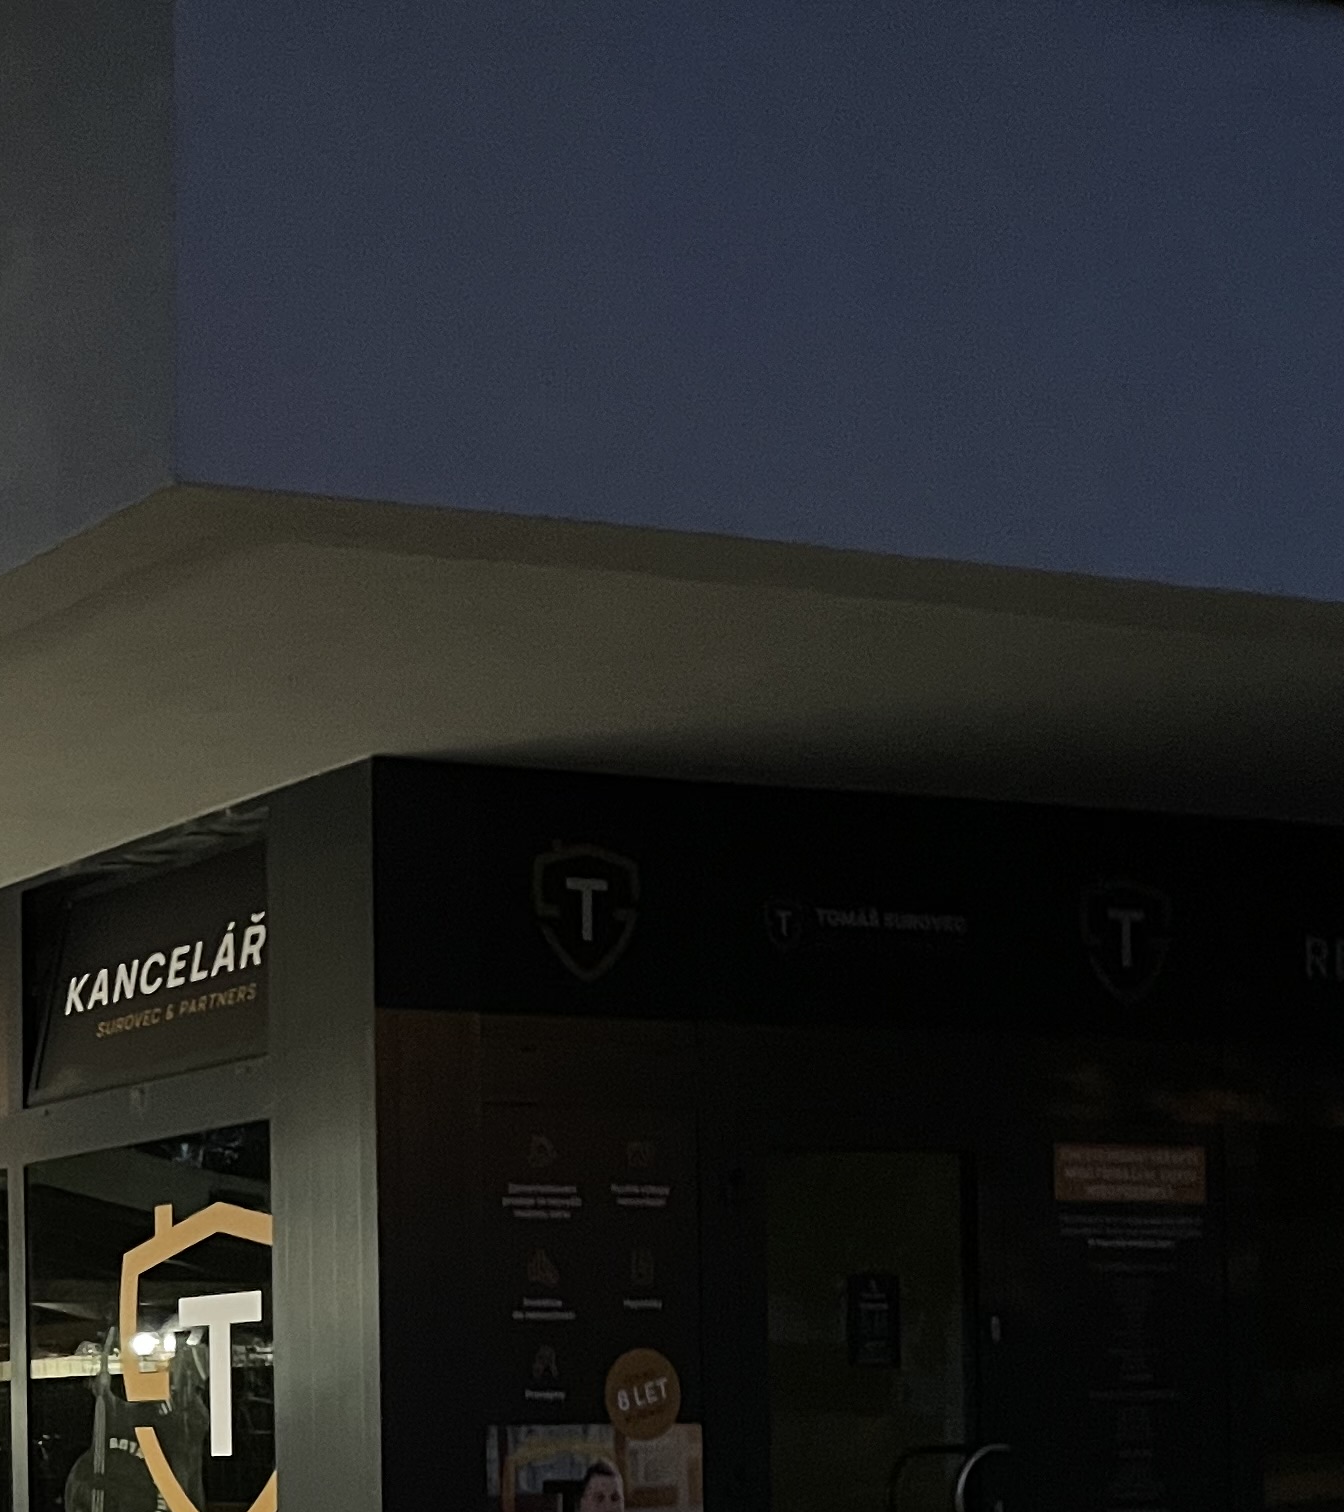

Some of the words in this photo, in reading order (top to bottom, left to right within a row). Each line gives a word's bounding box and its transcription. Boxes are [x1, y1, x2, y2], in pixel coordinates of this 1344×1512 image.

[64, 911, 267, 1016] KANCELÁŘ
[178, 982, 257, 1016] PARTNERS
[633, 1376, 668, 1407] LET
